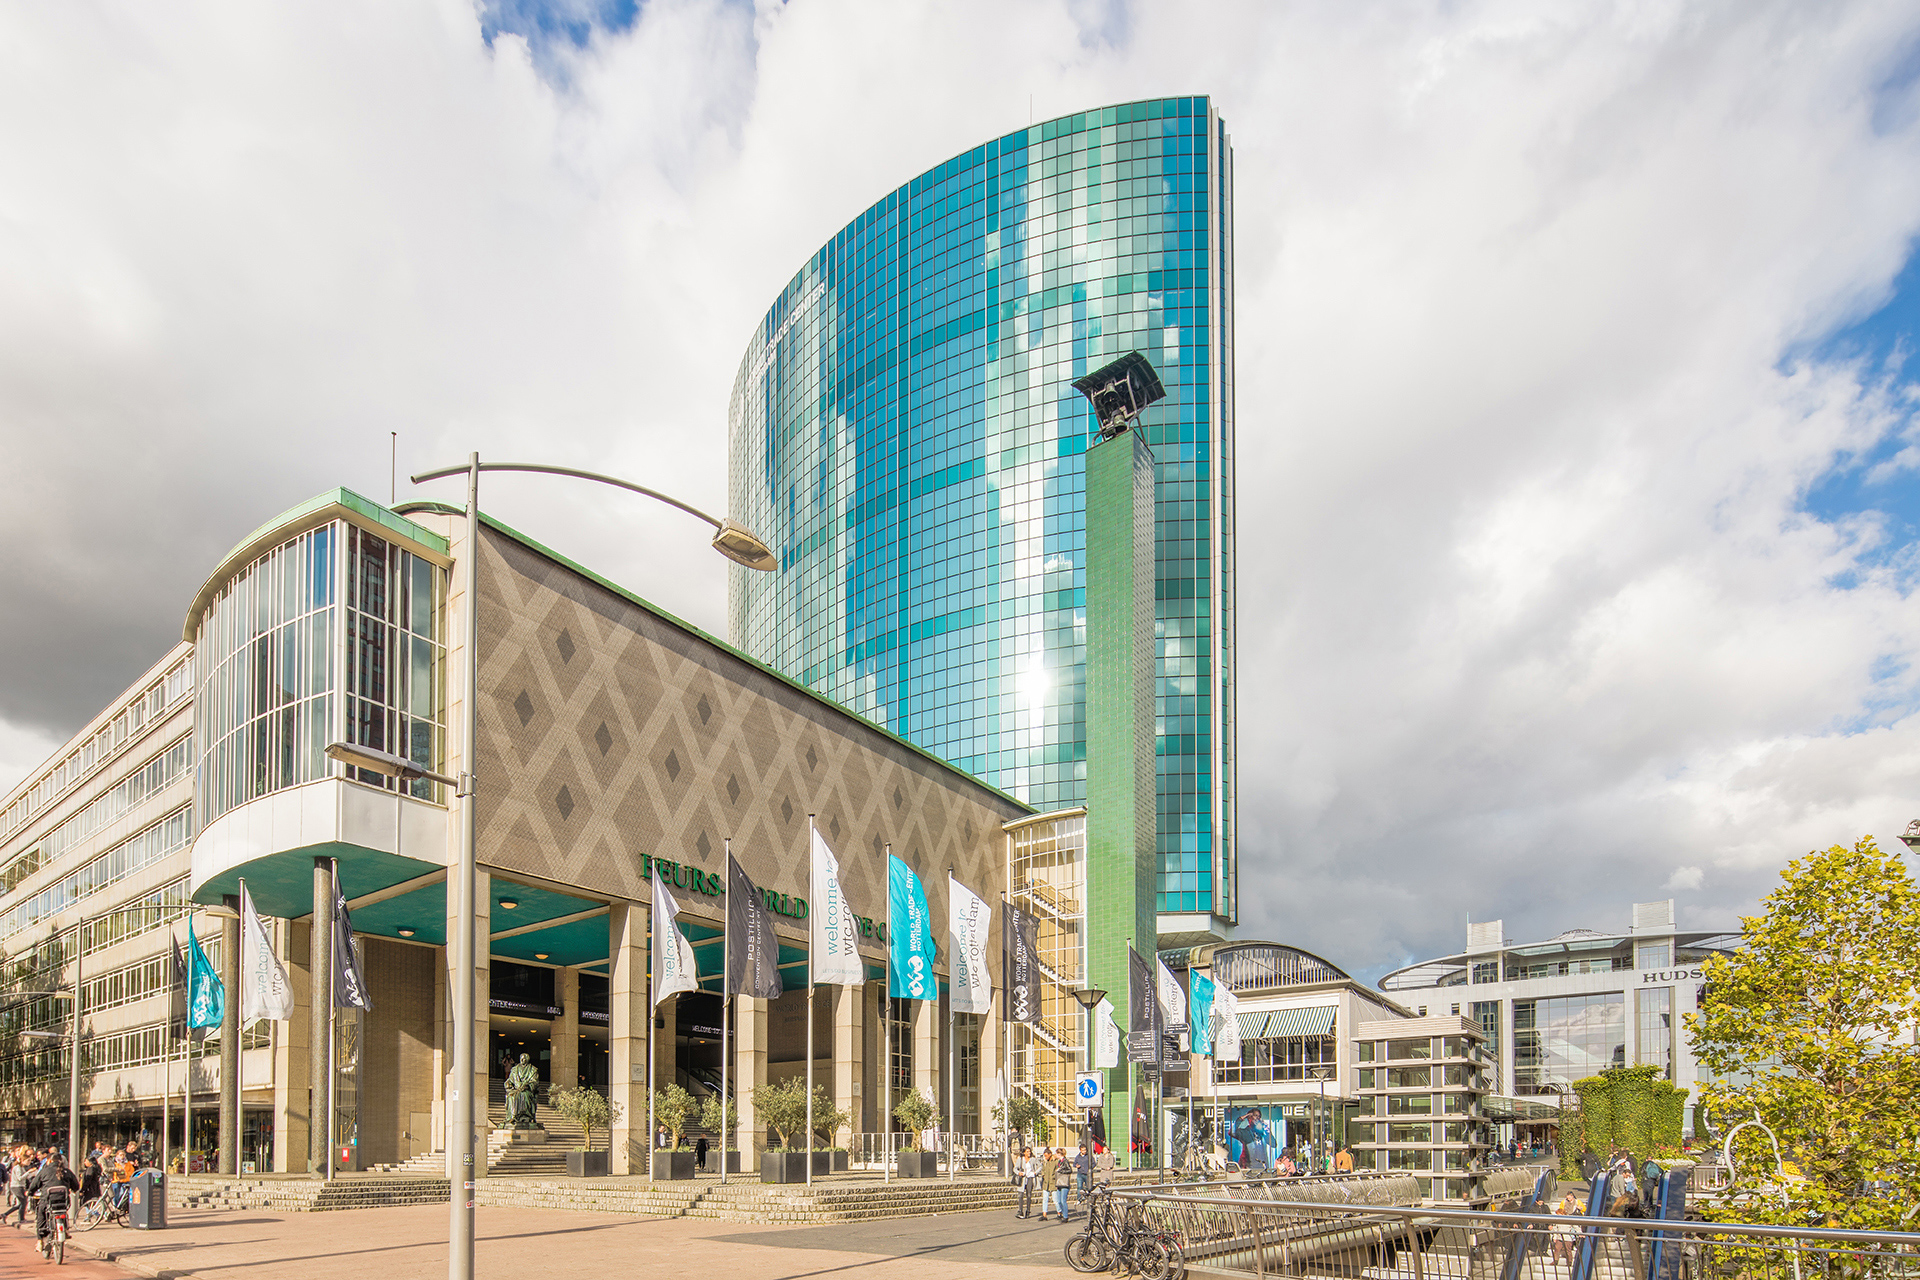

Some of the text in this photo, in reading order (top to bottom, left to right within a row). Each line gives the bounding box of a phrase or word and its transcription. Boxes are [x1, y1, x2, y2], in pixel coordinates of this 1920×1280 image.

[790, 281, 826, 326] CENTER
[825, 878, 839, 956] welcome
[1283, 1107, 1305, 1116] WE
